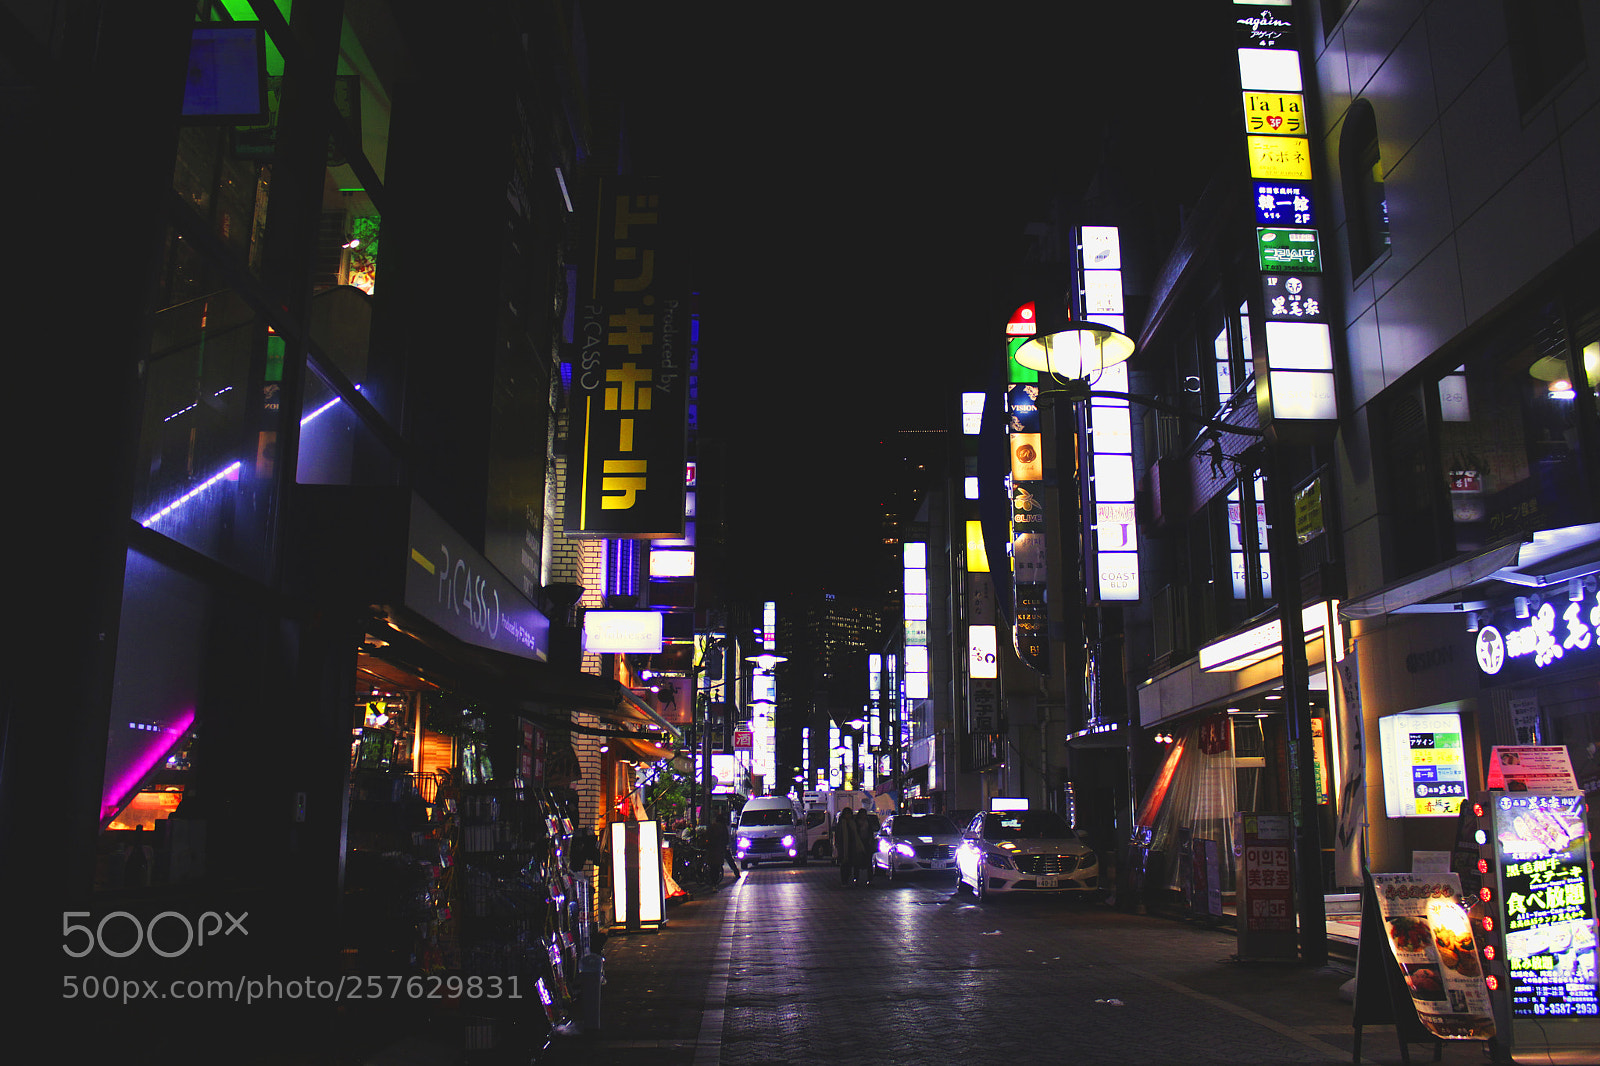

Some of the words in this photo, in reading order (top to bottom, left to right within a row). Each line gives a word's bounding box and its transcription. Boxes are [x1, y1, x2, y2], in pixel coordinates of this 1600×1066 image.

[1269, 119, 1282, 127] 3F
[1295, 213, 1311, 224] 2F
[1272, 295, 1320, 317] 黒毛家
[663, 299, 679, 361] Produced
[656, 365, 678, 393] by
[1015, 514, 1042, 523] OLIVE
[1101, 572, 1137, 581] COAST
[736, 733, 751, 746] 酒
[1248, 850, 1288, 867] 이희진
[1506, 858, 1560, 877] 黒毛和牛
[1529, 866, 1582, 884] ステーキ
[1248, 869, 1289, 887] 美容室
[1507, 883, 1586, 917] 食べ放題
[1269, 904, 1286, 914] 3F
[1511, 956, 1554, 970] 飲み放題
[1534, 1004, 1598, 1014] 03-3587-2959
